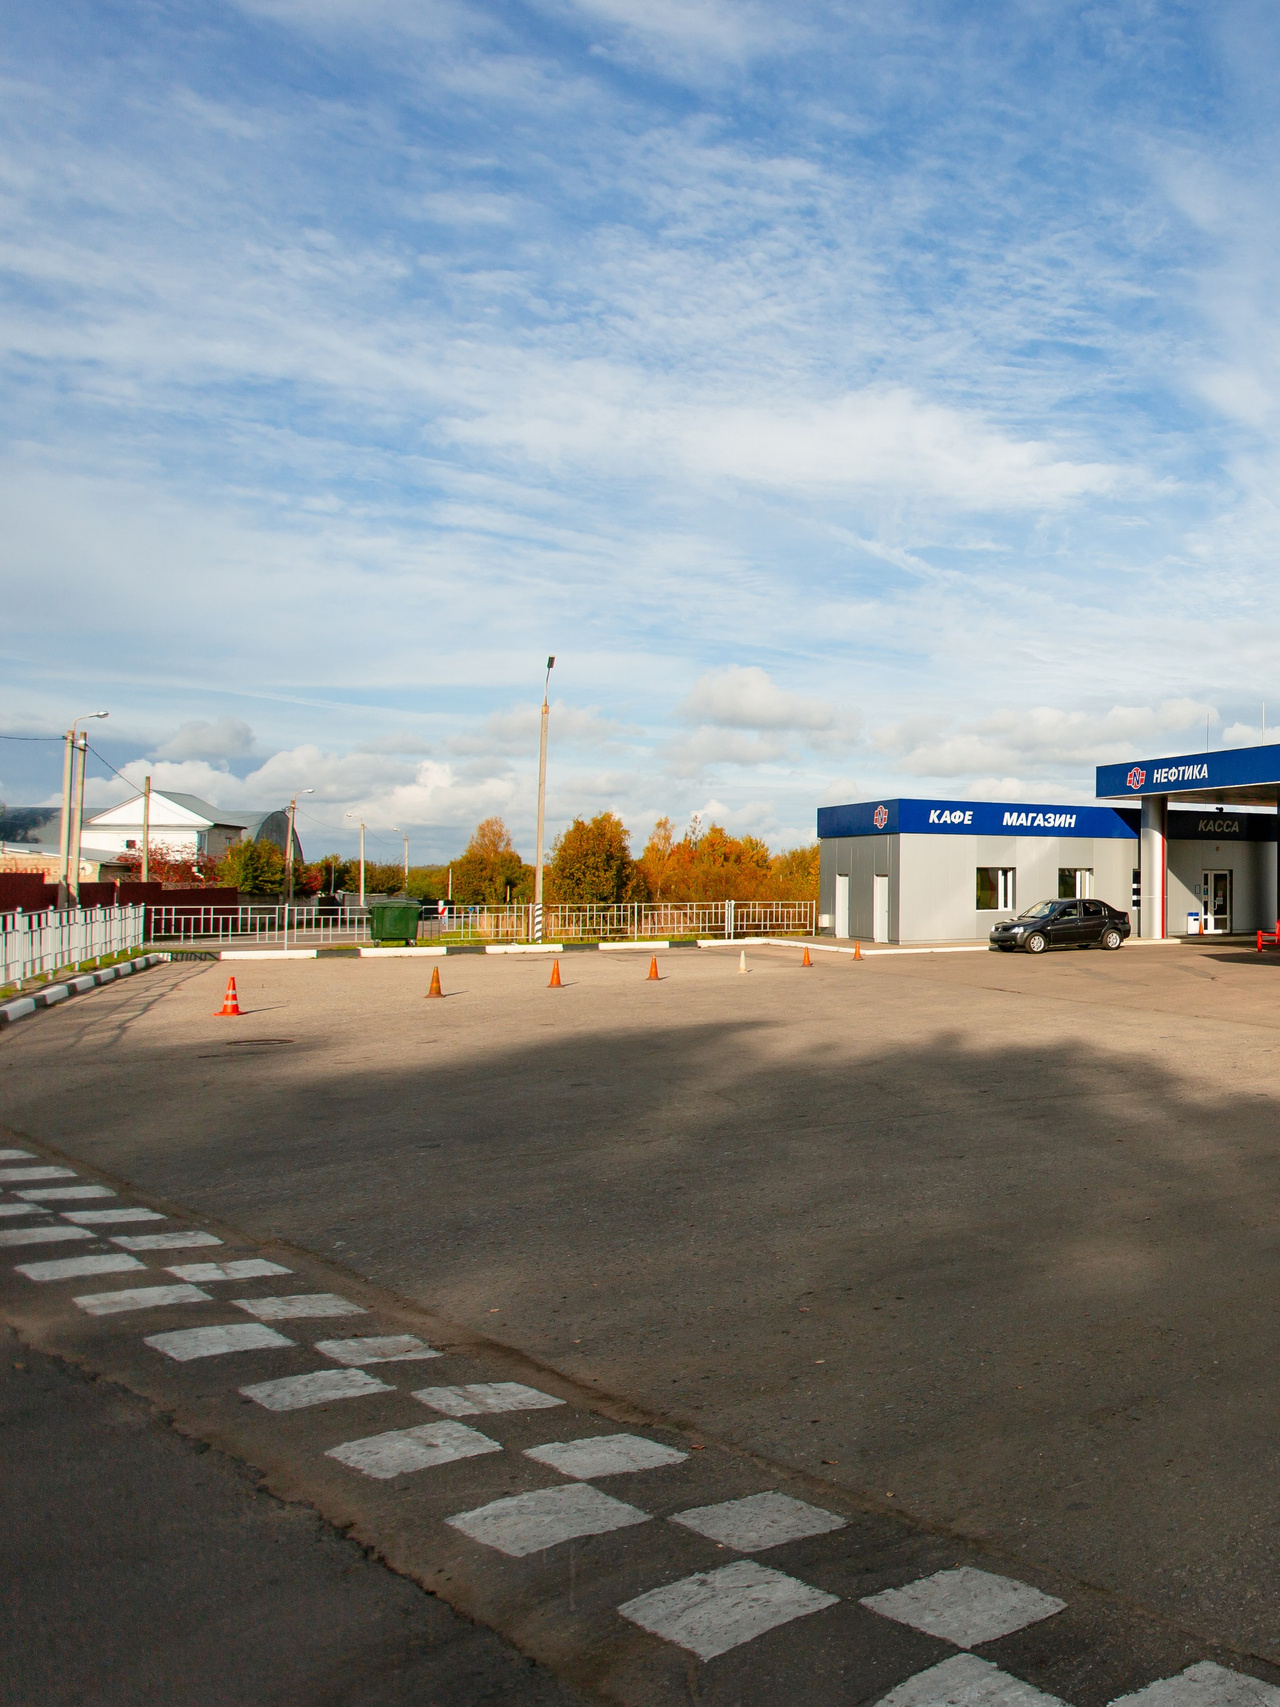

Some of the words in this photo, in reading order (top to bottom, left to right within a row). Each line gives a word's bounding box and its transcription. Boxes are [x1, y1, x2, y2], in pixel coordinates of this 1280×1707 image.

[1152, 763, 1209, 784] НЕФТИКА
[929, 809, 974, 825] КАФЕ
[1002, 811, 1077, 828] МАГАЗИН
[1198, 819, 1240, 833] КАССА
